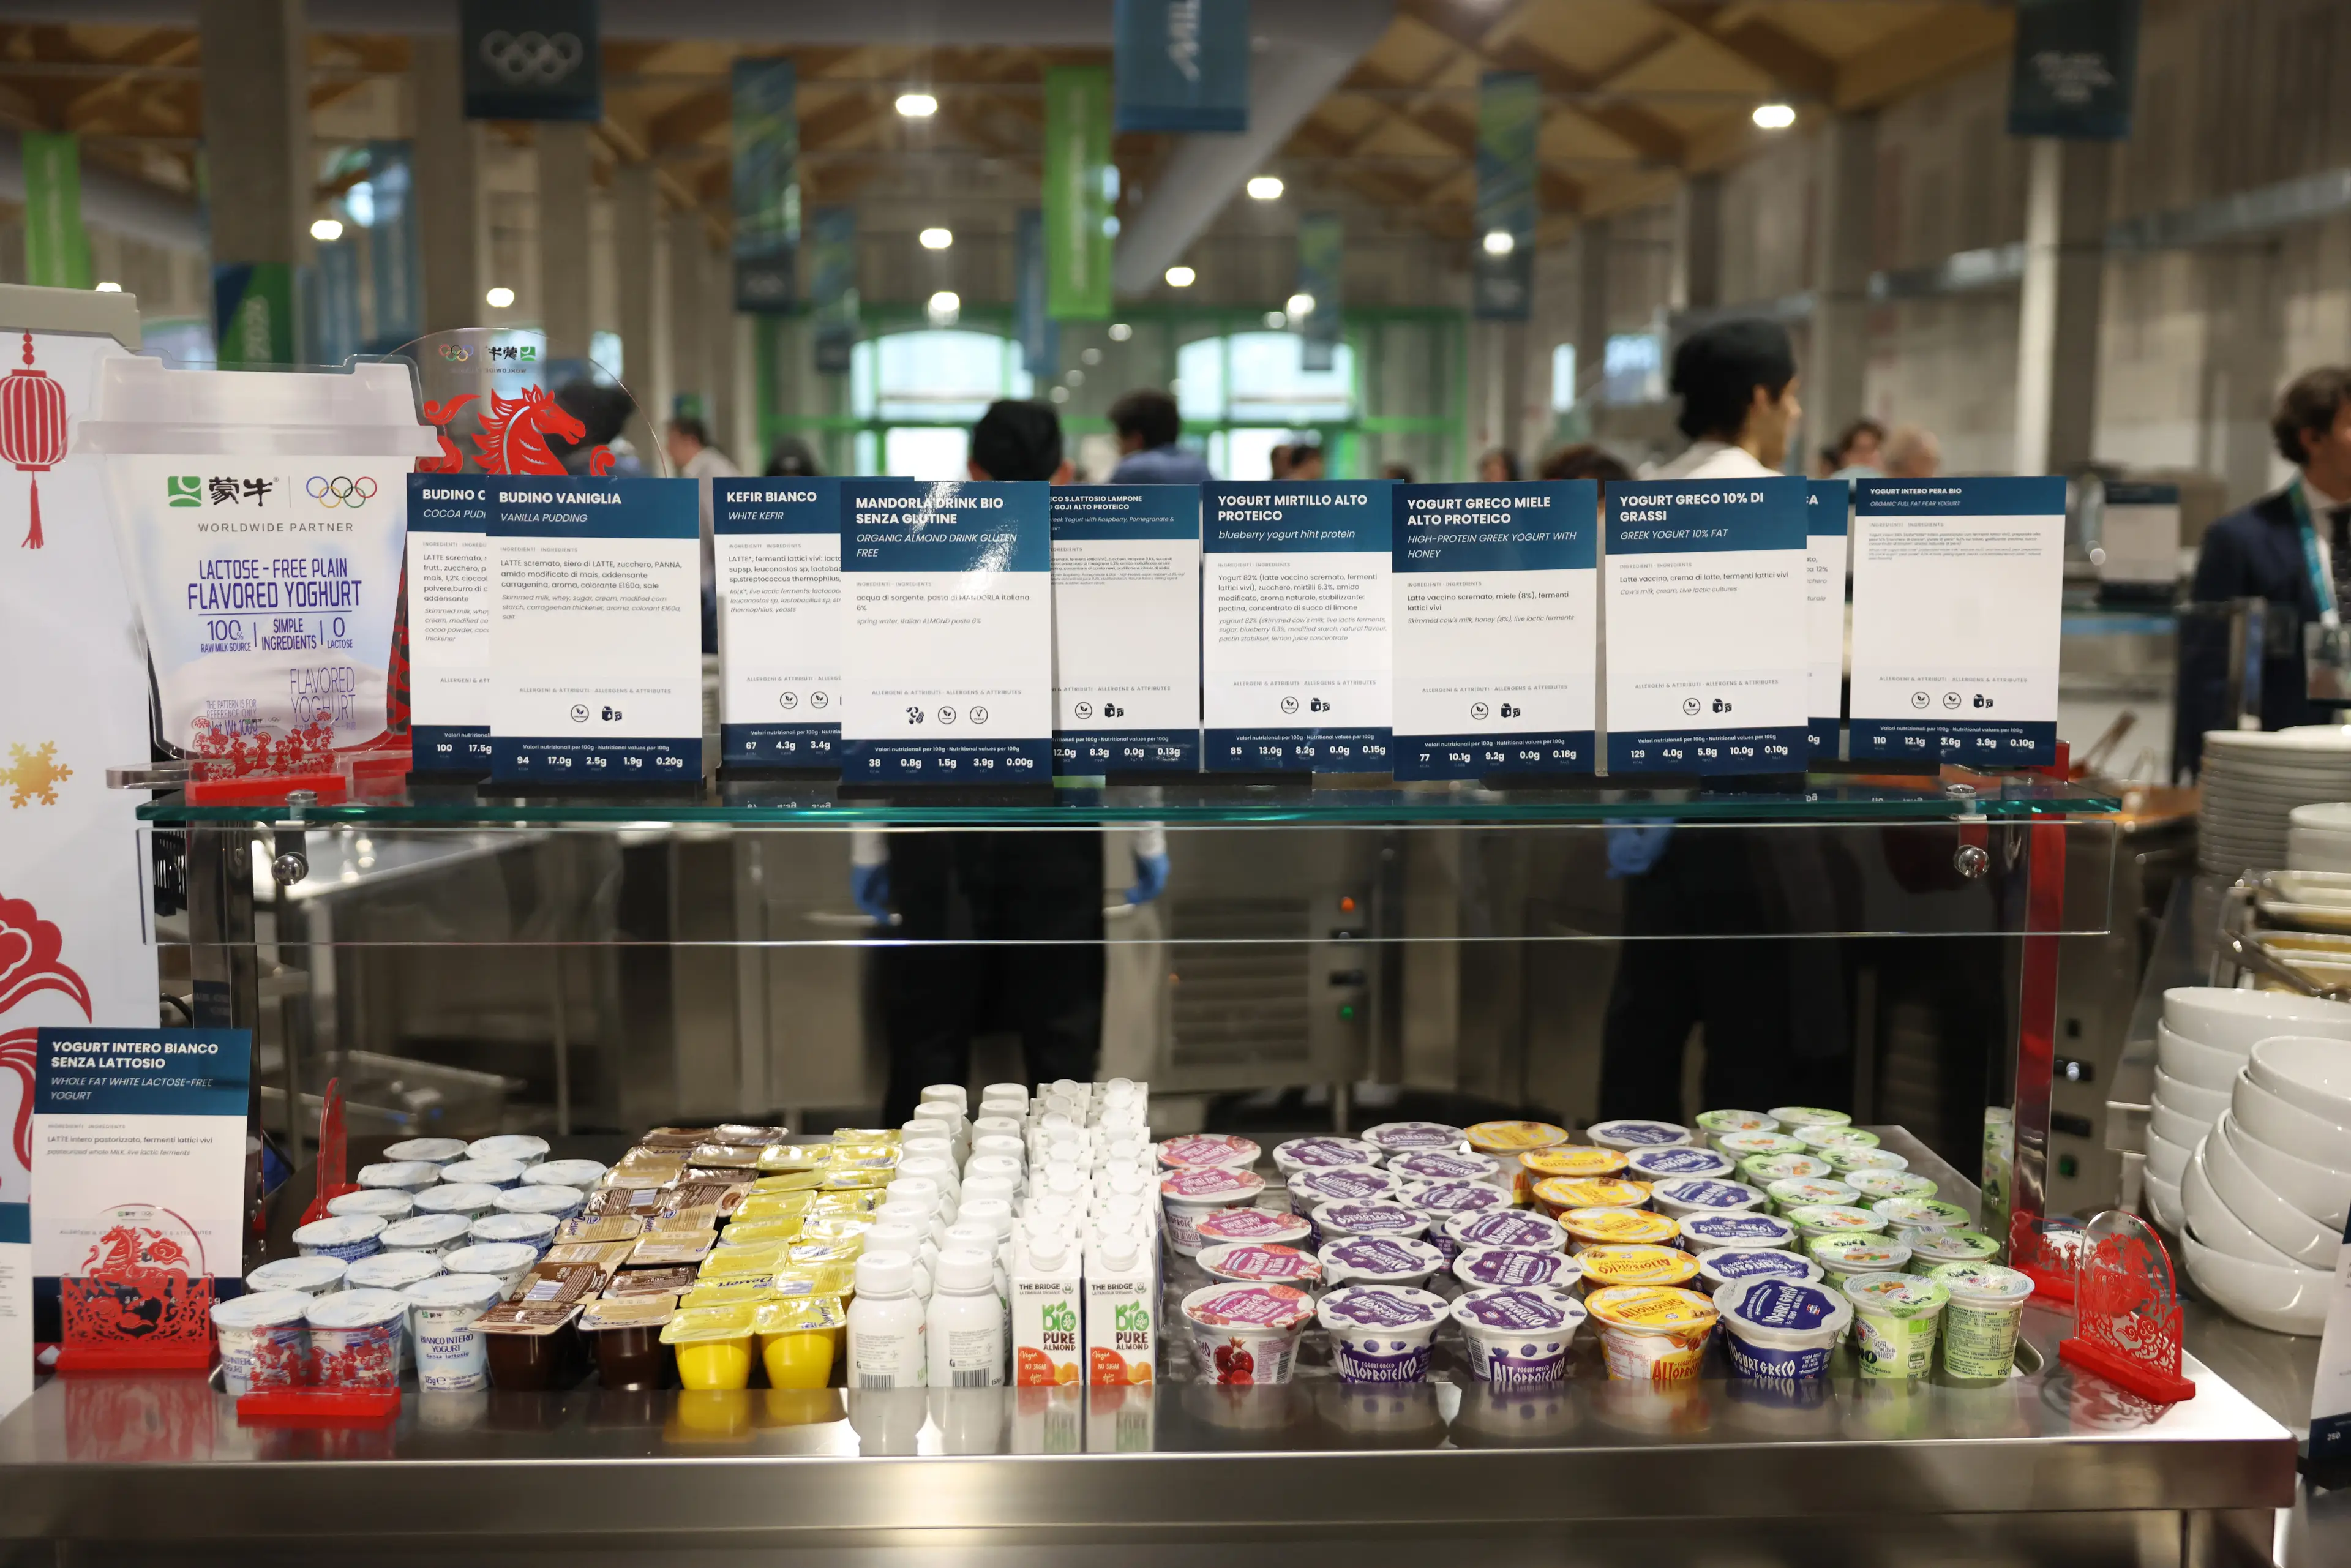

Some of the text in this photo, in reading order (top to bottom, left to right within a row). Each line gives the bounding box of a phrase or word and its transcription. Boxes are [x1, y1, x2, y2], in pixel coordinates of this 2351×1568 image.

[209, 476, 273, 507] 蒙牛
[422, 489, 475, 501] BUDINO
[727, 491, 817, 503] KEFIR BIANCO
[499, 491, 622, 505] BUDINO VANIGLIA
[856, 497, 1004, 509] MANDORLA DRINK BIO
[1218, 494, 1368, 507] YOGURT MIRTILLO ALTO
[1407, 496, 1550, 511] YOGURT GRECO MIELE
[1619, 492, 1764, 507] YOGURT GRECO 10% DI
[423, 509, 461, 519] COCOA
[501, 512, 588, 523] VANILLA PUDDING
[729, 511, 784, 520] WHITE KEFIR
[856, 512, 958, 525] SENZA GLUTINE
[1218, 510, 1283, 522] PROTEICO
[1407, 512, 1511, 526] ALTO PROTEICO
[1619, 509, 1667, 522] GRASSI
[198, 522, 353, 533] WORLDWIDE PARTNER
[857, 533, 1018, 544] ORGANIC ALMOND DRINK GLUTEN
[1218, 529, 1355, 542] blueberry yogurt hiht protein
[1408, 531, 1577, 544] HIGH-PROTEIN GREEK YOGURT WITH
[1620, 528, 1729, 541] GREEK YOGURT 10% FAT
[857, 548, 879, 558] FREE
[1408, 549, 1441, 559] HONEY
[311, 557, 348, 579] PLAIN
[563, 559, 582, 568] siero
[592, 560, 615, 569] LATTE,
[617, 560, 653, 569] zucchero,
[1218, 574, 1242, 583] Yogurt
[1259, 572, 1279, 582] (latte
[187, 580, 362, 610] FLAVORED YOGHURT
[273, 617, 304, 634] SIMPLE
[332, 617, 345, 638] 0
[200, 642, 252, 654] RAW MILK SOURCE
[261, 634, 317, 651] INGREDIENTS
[327, 639, 353, 650] LACTOSE
[290, 666, 356, 694] FLAVORED
[206, 699, 257, 708] THE PATTERN IS FOR
[290, 695, 356, 723] YOGHURT
[206, 708, 257, 718] REFERENCE ONLY
[1873, 736, 2035, 750] 110 12.1g 3.6g 3.9g 0.10g
[517, 755, 683, 768] 94 17.0g 2.5g 1.9g 0.20g
[52, 1041, 219, 1055] YOGURT INTERO BIANCO
[51, 1056, 165, 1069] SENZA LATTOSIO
[51, 1076, 212, 1088] WHOLE FAT WHITE LACTOSE-FREE
[51, 1090, 92, 1100] YOGURT
[47, 1135, 69, 1144] LATTE
[94, 1136, 143, 1146] pastorizzato,
[420, 1334, 474, 1345] BIANCO INTERO
[1043, 1332, 1076, 1344] PURE
[1116, 1332, 1149, 1343] PURE
[1760, 1360, 1796, 1377] GRECO
